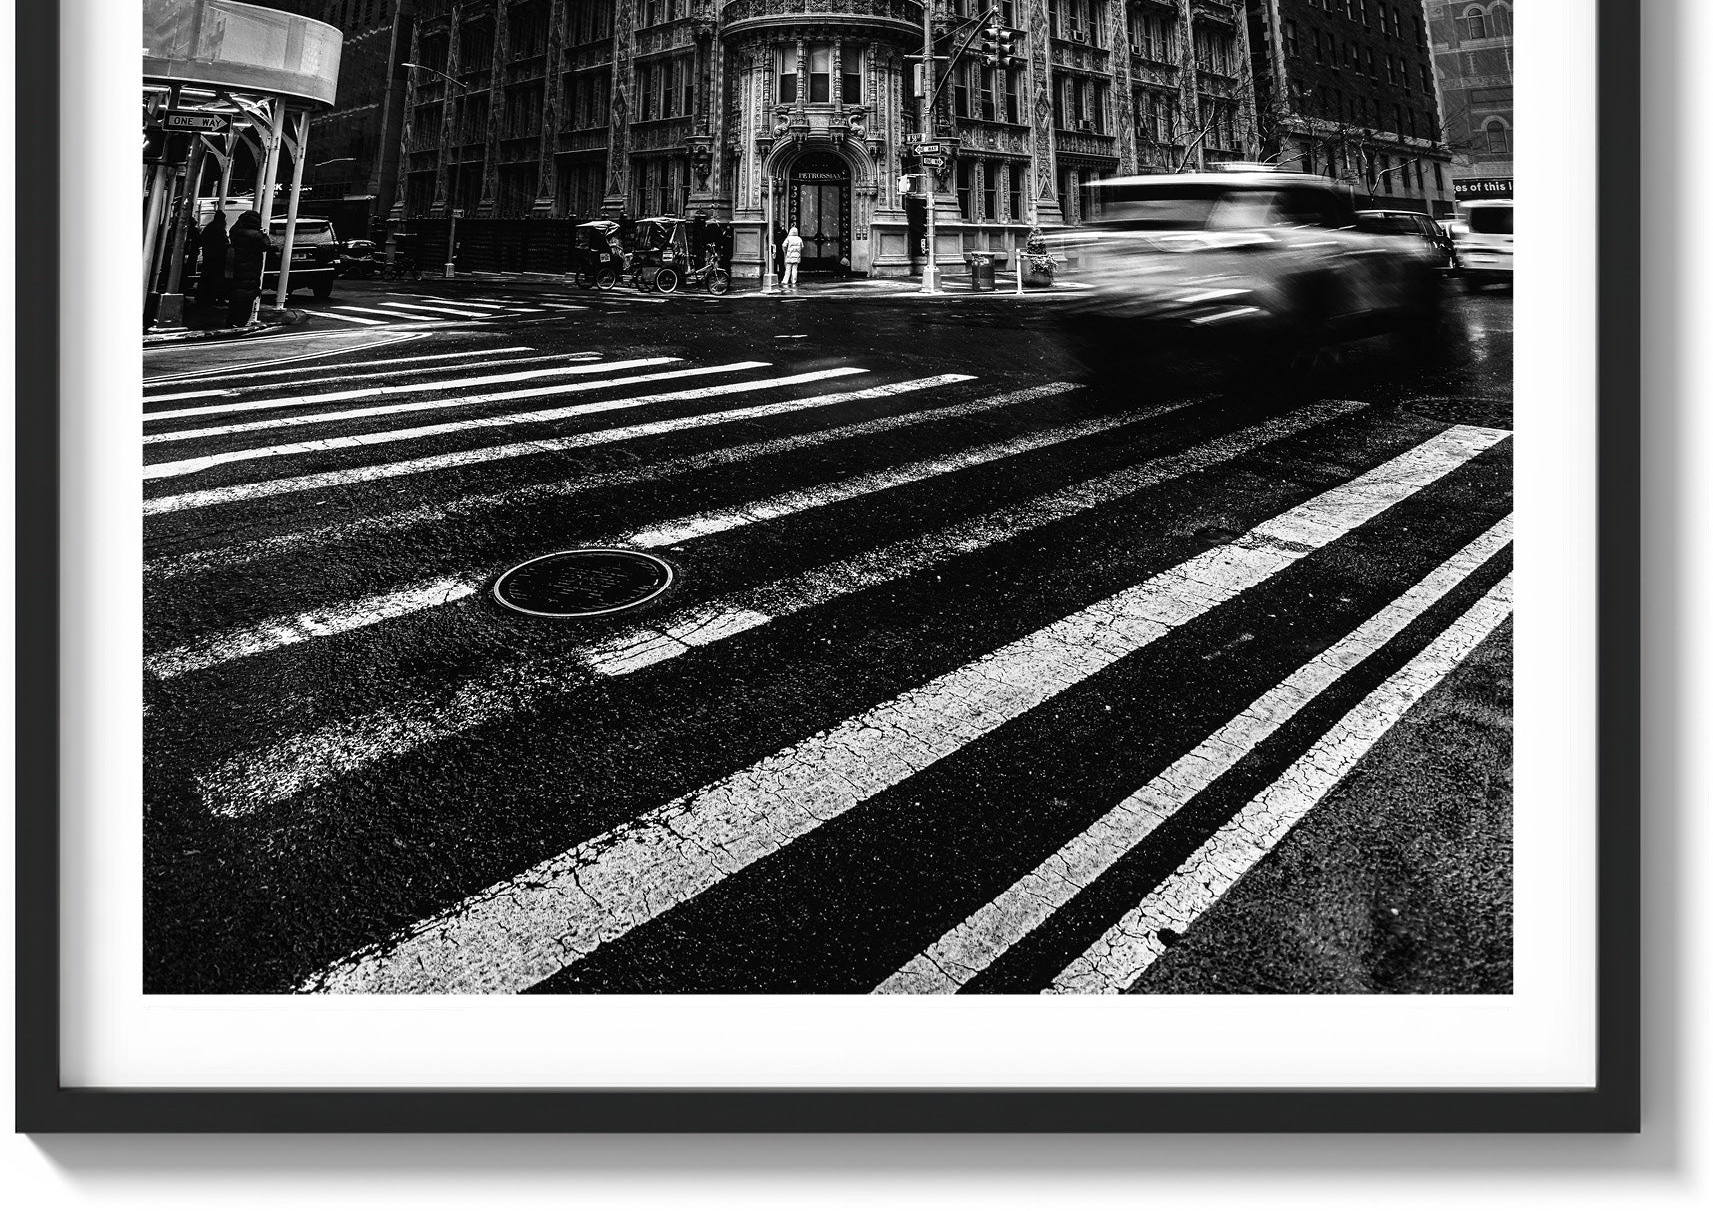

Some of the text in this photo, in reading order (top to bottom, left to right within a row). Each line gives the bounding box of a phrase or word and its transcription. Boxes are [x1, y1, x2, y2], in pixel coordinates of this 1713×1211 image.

[173, 116, 221, 128] ONE WAY
[1453, 184, 1468, 194] es
[1470, 182, 1481, 191] of
[1484, 181, 1506, 191] this
